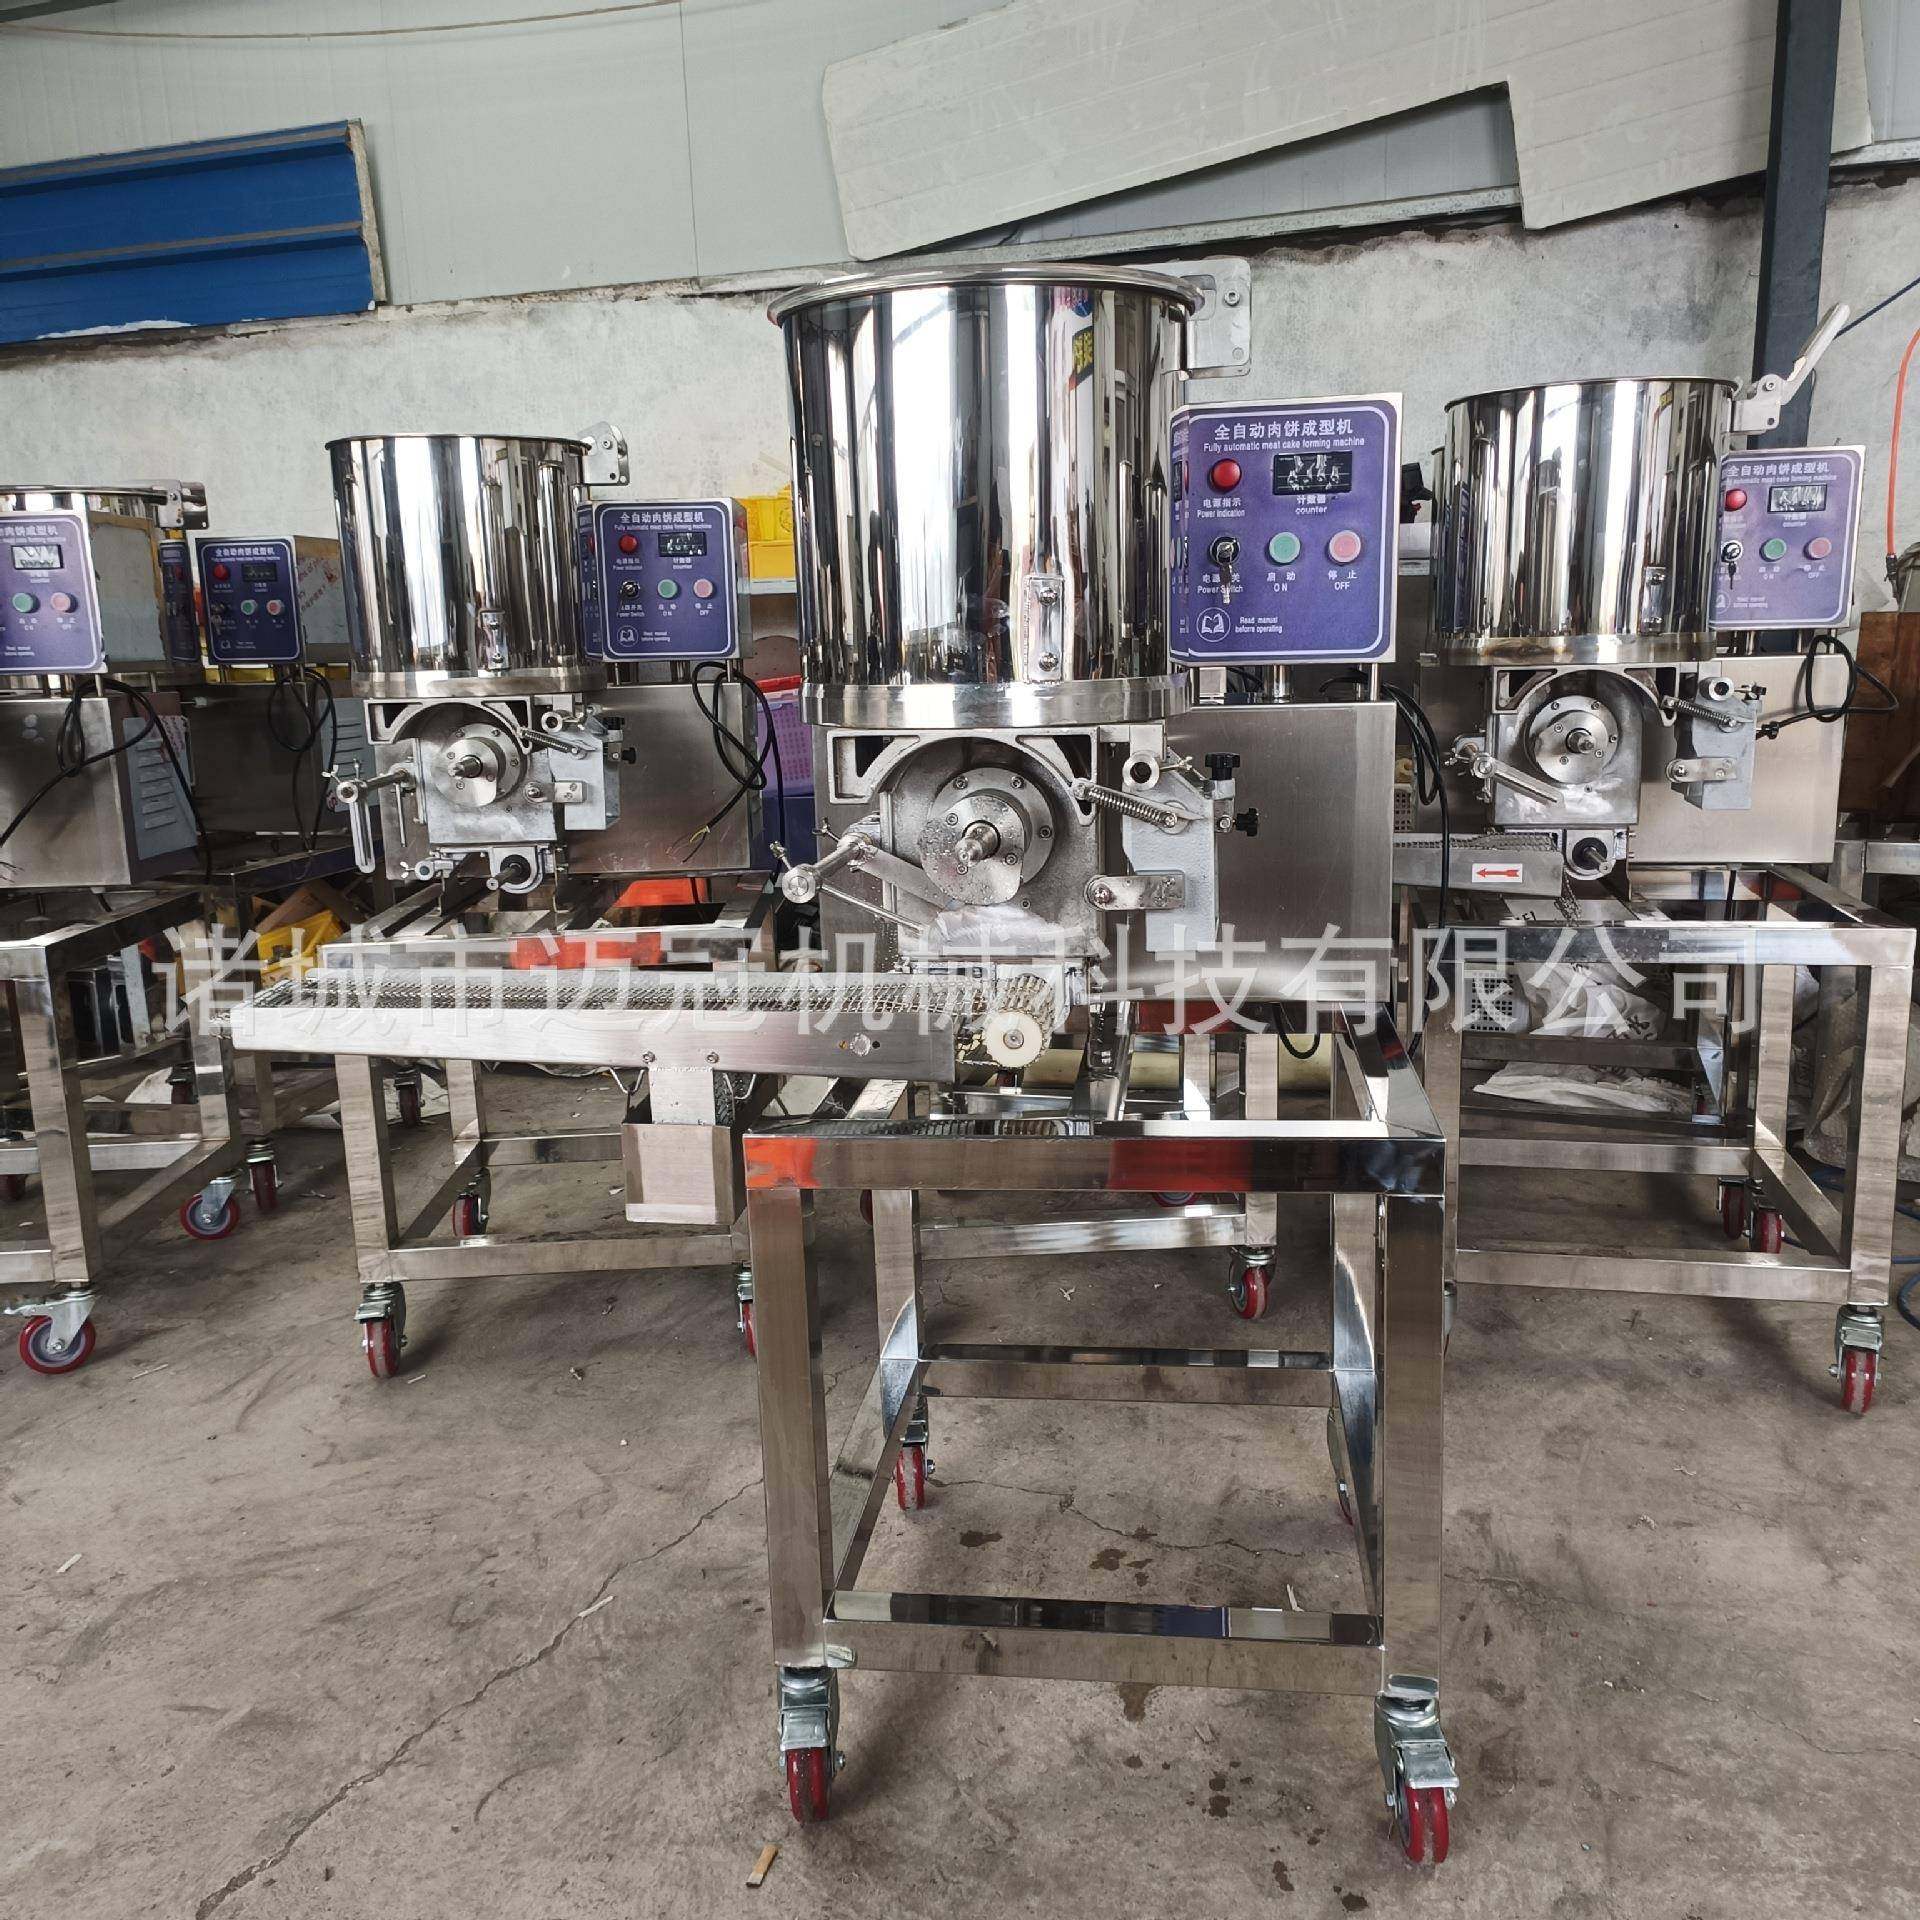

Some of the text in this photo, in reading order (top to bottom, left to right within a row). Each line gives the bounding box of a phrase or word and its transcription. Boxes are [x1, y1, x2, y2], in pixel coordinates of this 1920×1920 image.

[1214, 418, 1353, 441] 全自动肉饼成型机
[1203, 437, 1365, 454] Fully automatic meat cake forming machine
[1727, 462, 1829, 477] 全自动肉饼成型机
[1203, 498, 1241, 508] 电源指示
[1197, 508, 1246, 518] Power Indication
[1295, 506, 1328, 514] counter
[620, 512, 704, 523] 全自动肉饼成型机
[1202, 573, 1240, 583] 电源关
[1197, 585, 1219, 594] Power
[1334, 581, 1351, 591] OFF
[1240, 616, 1278, 624] Read manual
[1256, 625, 1283, 634] operating
